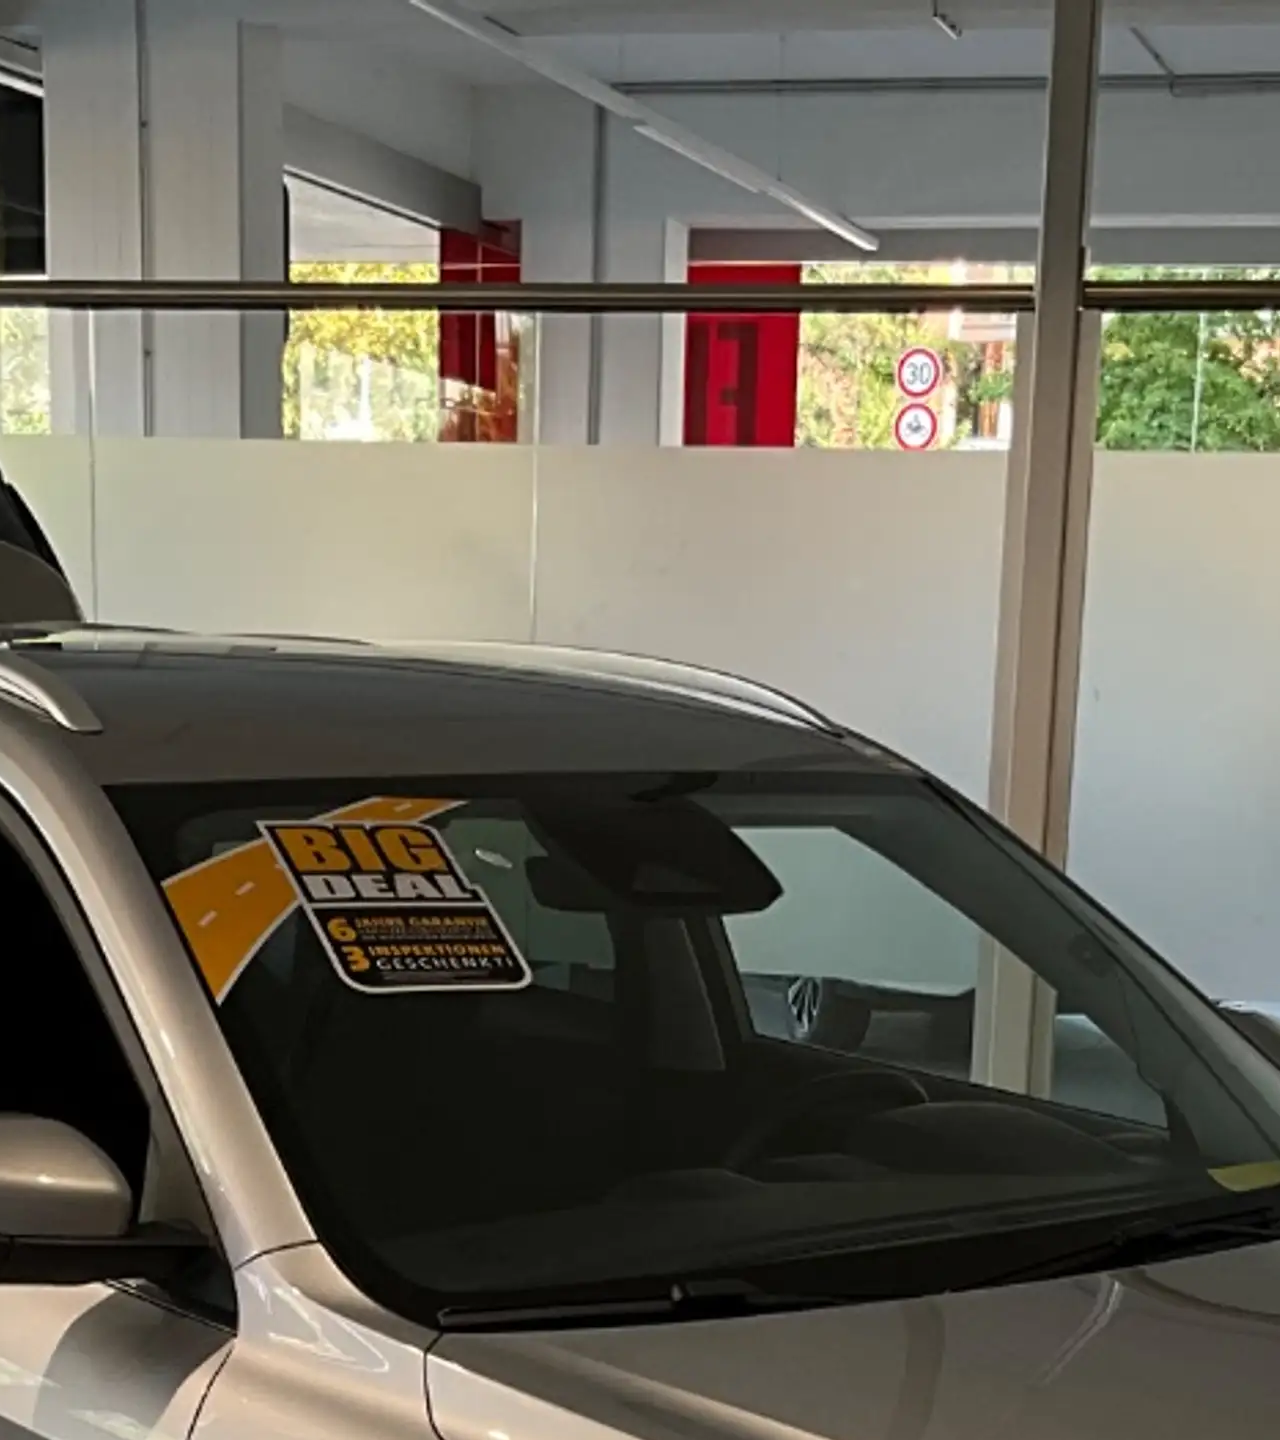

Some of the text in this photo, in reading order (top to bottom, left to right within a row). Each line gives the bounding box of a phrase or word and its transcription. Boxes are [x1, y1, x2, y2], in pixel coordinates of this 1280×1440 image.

[906, 362, 932, 385] 30
[274, 826, 450, 872] BIG
[300, 874, 473, 899] DEAL
[328, 916, 357, 942] 6
[341, 943, 507, 972] 3 INSPEKTIONEN
